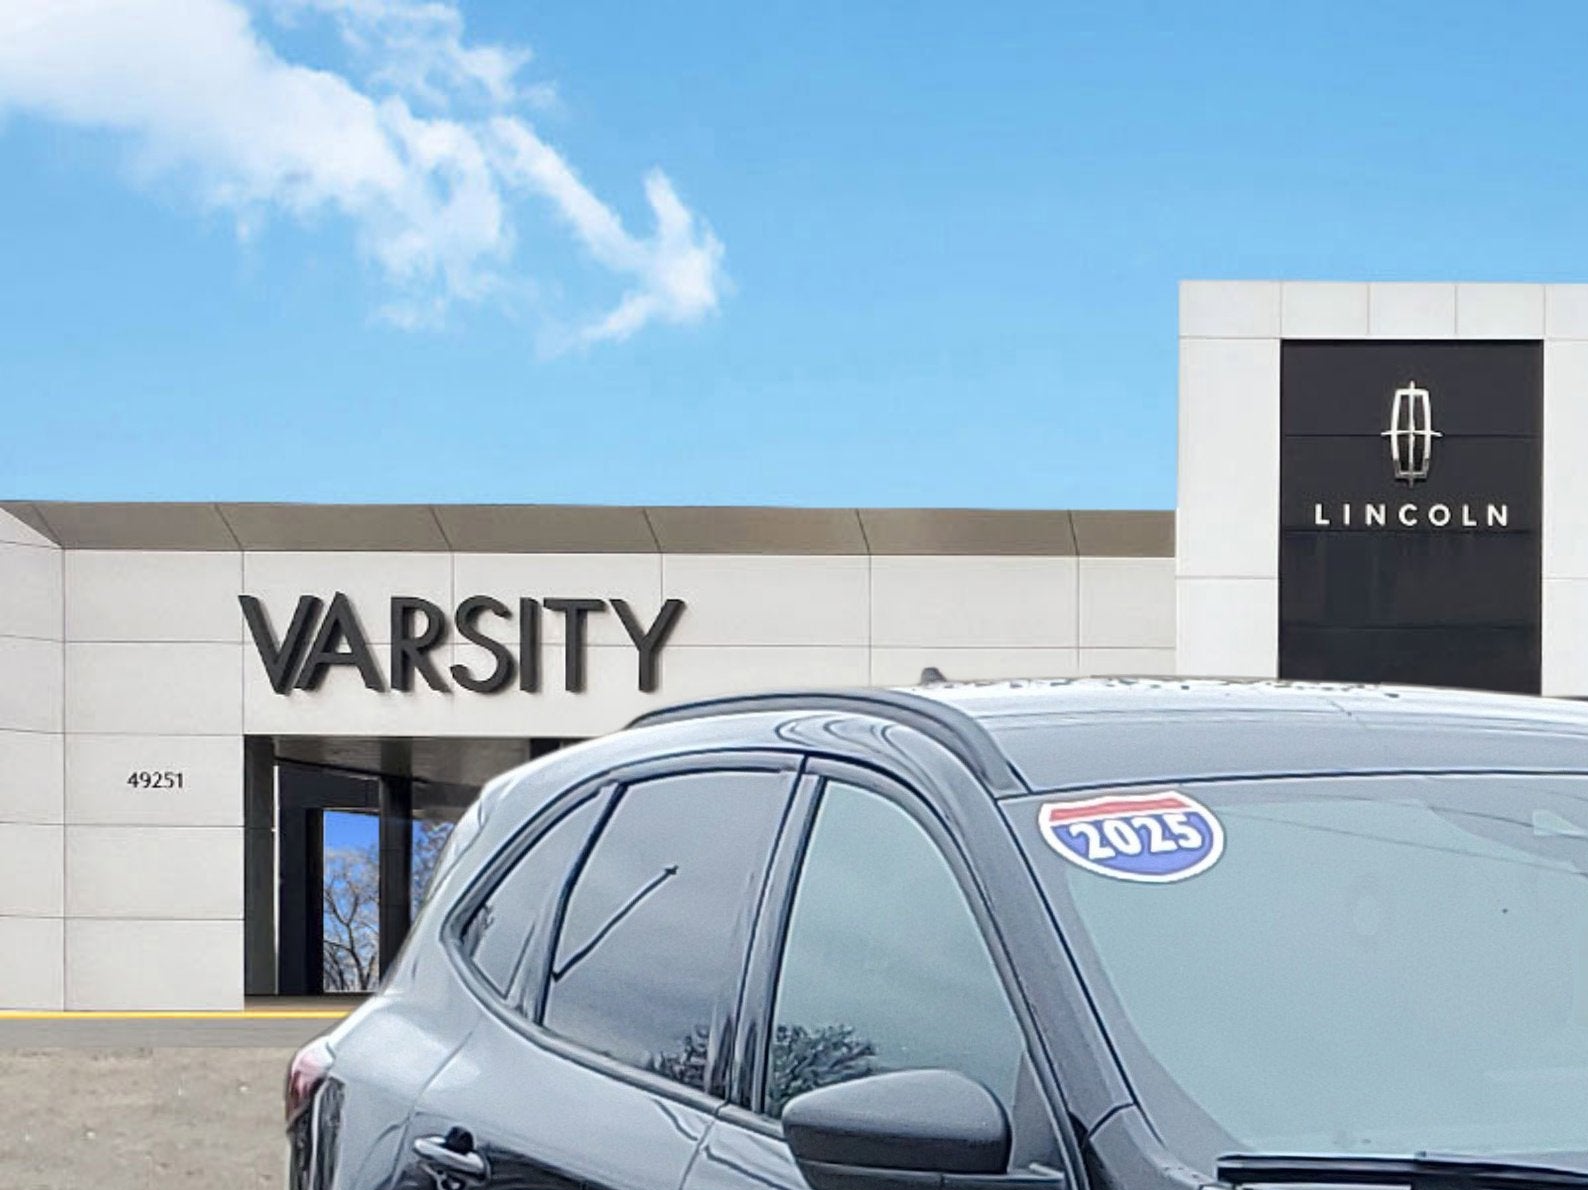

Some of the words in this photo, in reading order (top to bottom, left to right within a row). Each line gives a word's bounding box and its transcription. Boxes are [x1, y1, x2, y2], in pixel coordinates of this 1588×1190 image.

[1314, 503, 1508, 526] LINCOLN
[238, 592, 686, 695] VARSITY
[126, 771, 183, 788] 49251
[1069, 814, 1202, 860] 2025
